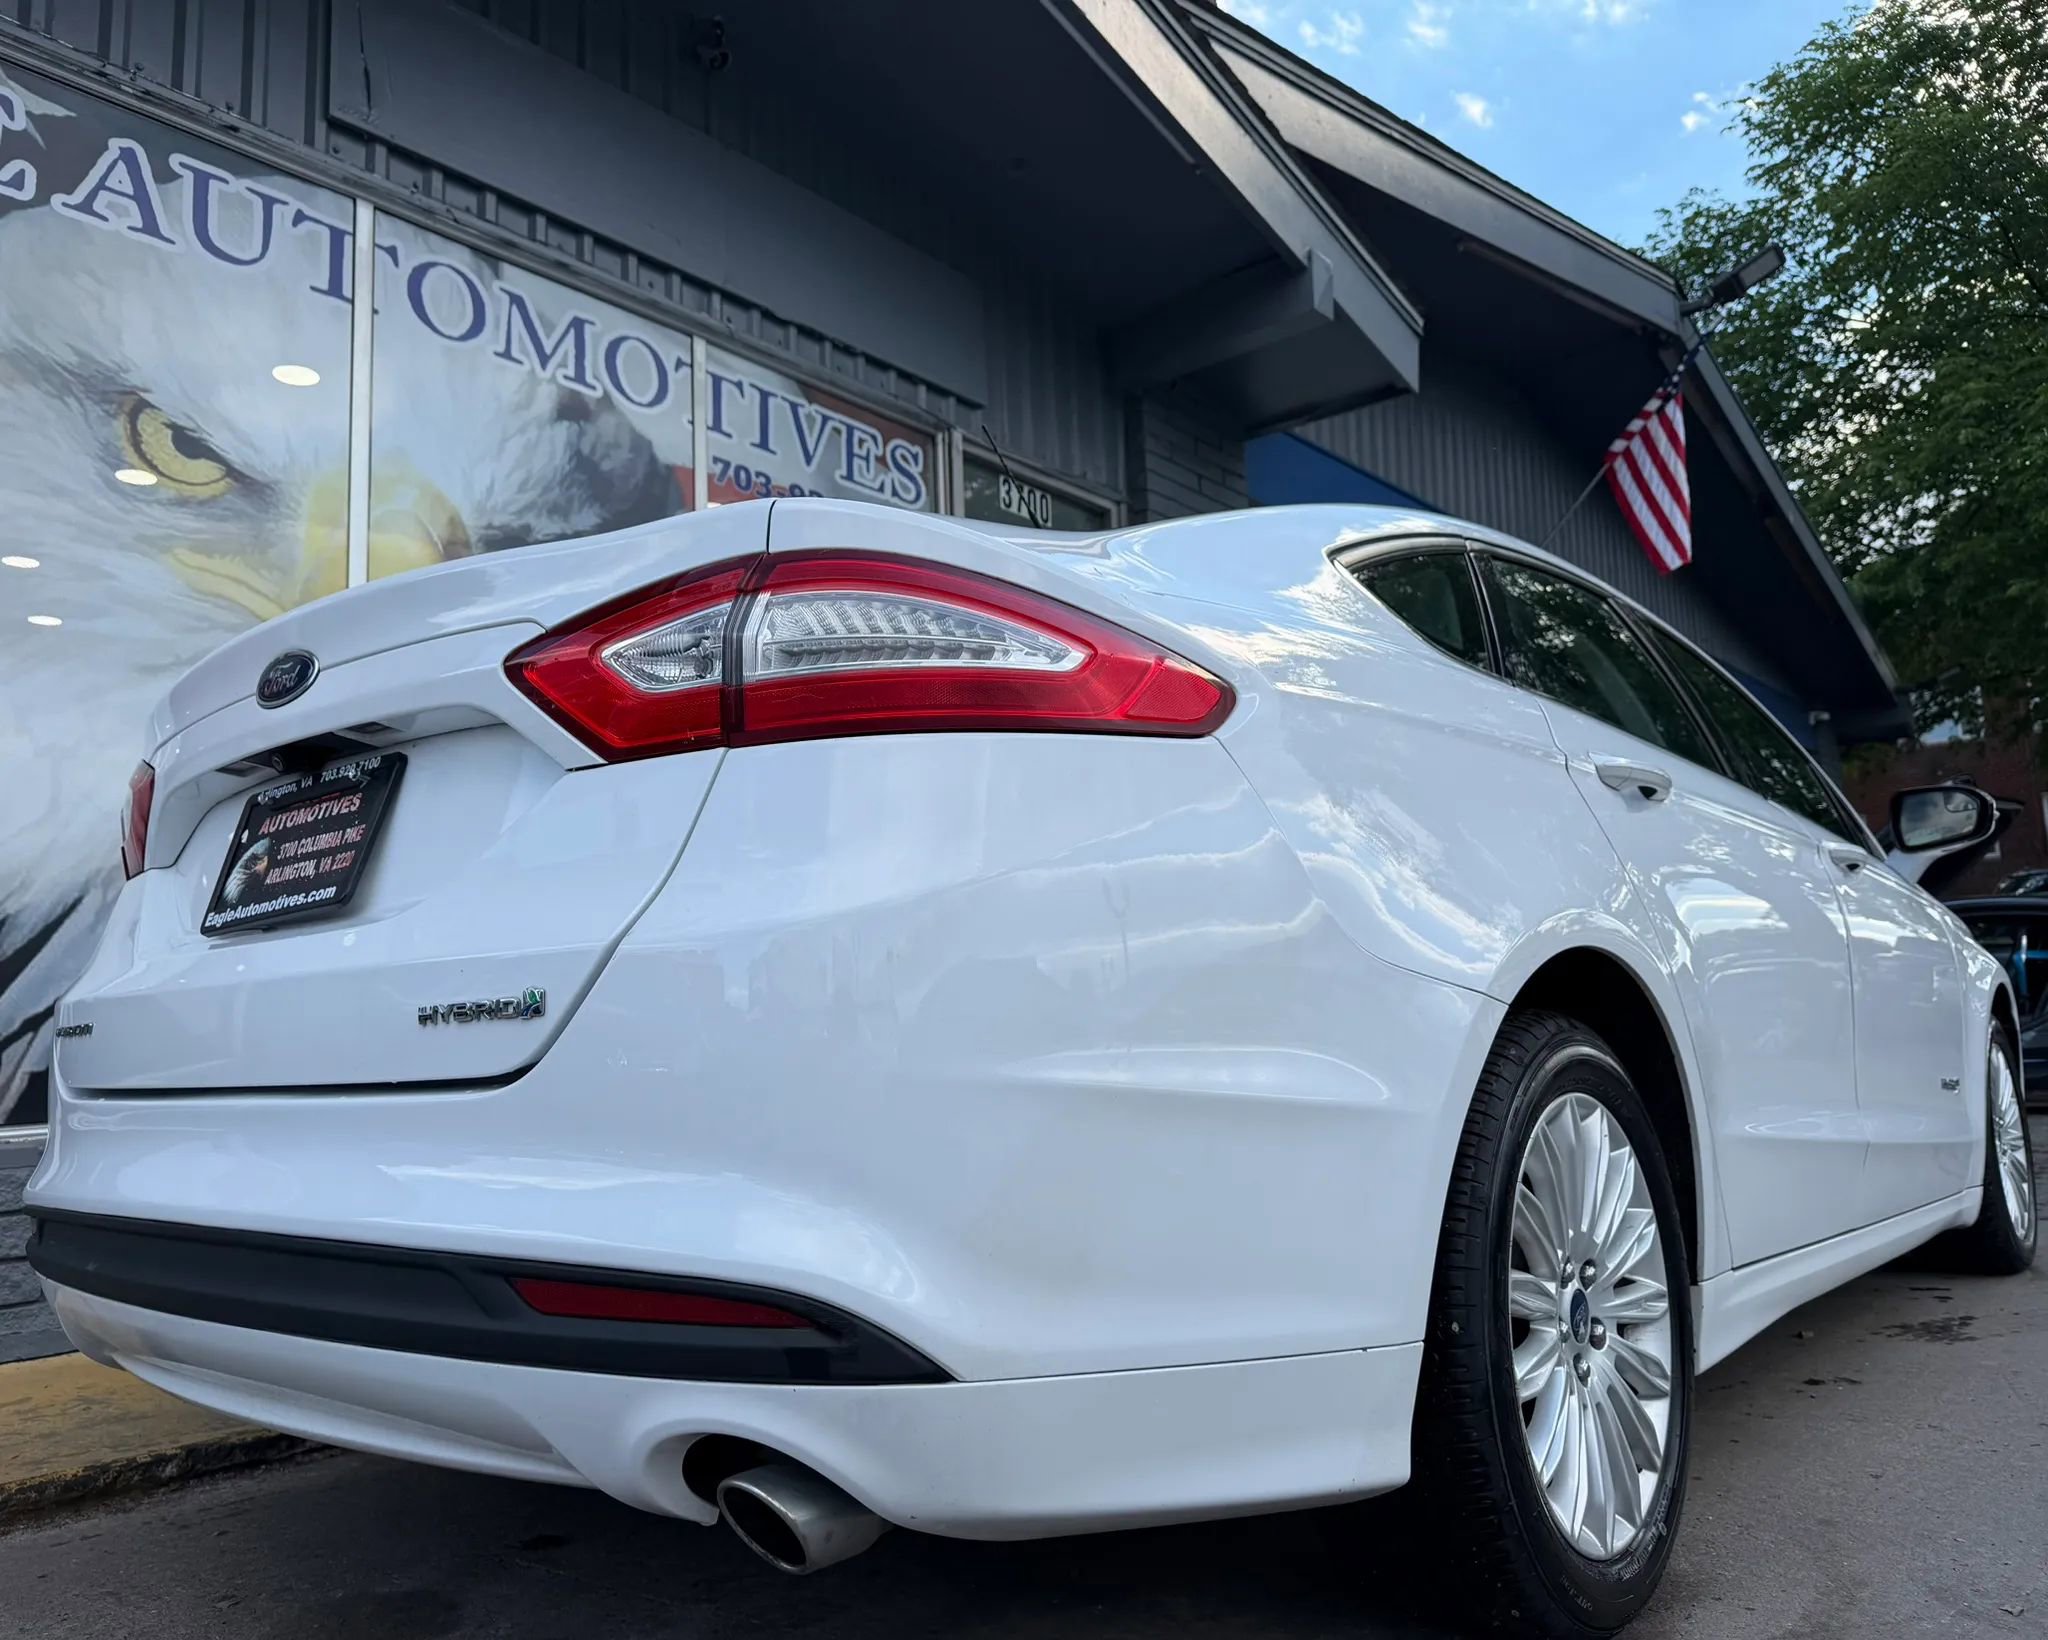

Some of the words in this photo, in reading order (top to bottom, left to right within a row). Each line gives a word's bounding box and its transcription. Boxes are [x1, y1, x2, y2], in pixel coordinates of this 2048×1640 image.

[58, 143, 924, 506] AUTOMOTIVES
[712, 455, 825, 498] 703-
[1002, 477, 1049, 524] 3700
[301, 775, 313, 789] VA
[258, 793, 363, 835] AUTOMOTIVES
[297, 830, 343, 857] COLUMBIA
[341, 823, 366, 845] PIKE
[264, 860, 317, 885] ARLINGTON,
[319, 856, 333, 873] VA
[204, 886, 337, 928] EagleAutomotives.com
[418, 996, 521, 1027] HYBRID
